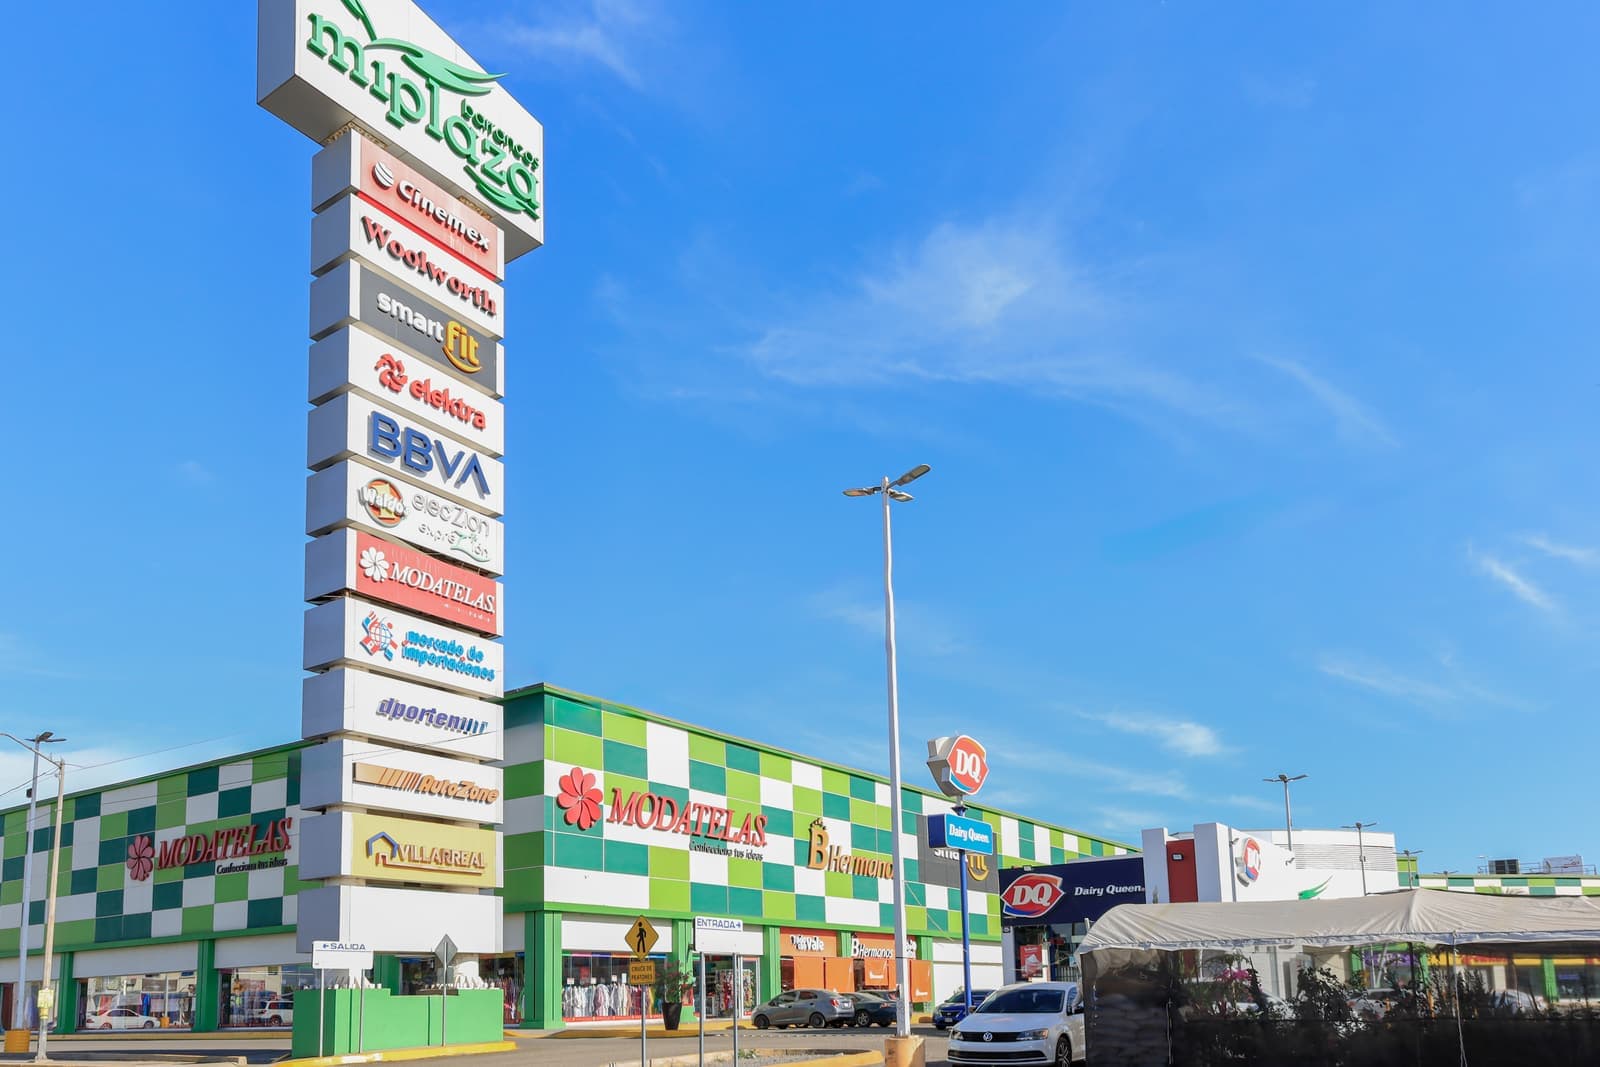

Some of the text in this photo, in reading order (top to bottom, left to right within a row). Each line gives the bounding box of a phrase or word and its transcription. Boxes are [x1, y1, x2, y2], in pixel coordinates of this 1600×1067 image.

[397, 180, 490, 252] Cinemex
[361, 216, 497, 316] Woolworth
[377, 293, 480, 366] smart fit
[410, 378, 486, 431] elektra
[369, 411, 491, 497] BBVA
[389, 561, 496, 614] MODATELAS
[402, 640, 495, 681] importaciones
[406, 631, 485, 663] mercado de
[956, 748, 981, 783] DQ
[419, 775, 499, 804] AutoZone
[606, 788, 768, 848] MODATELAS
[949, 824, 989, 843] Dairy Queen
[157, 817, 293, 870] MODATELAS
[399, 844, 486, 869] VILLARREAL
[1012, 882, 1053, 906] DQ
[1074, 884, 1142, 896] Dairy Queen
[696, 917, 736, 929] ENTRADA
